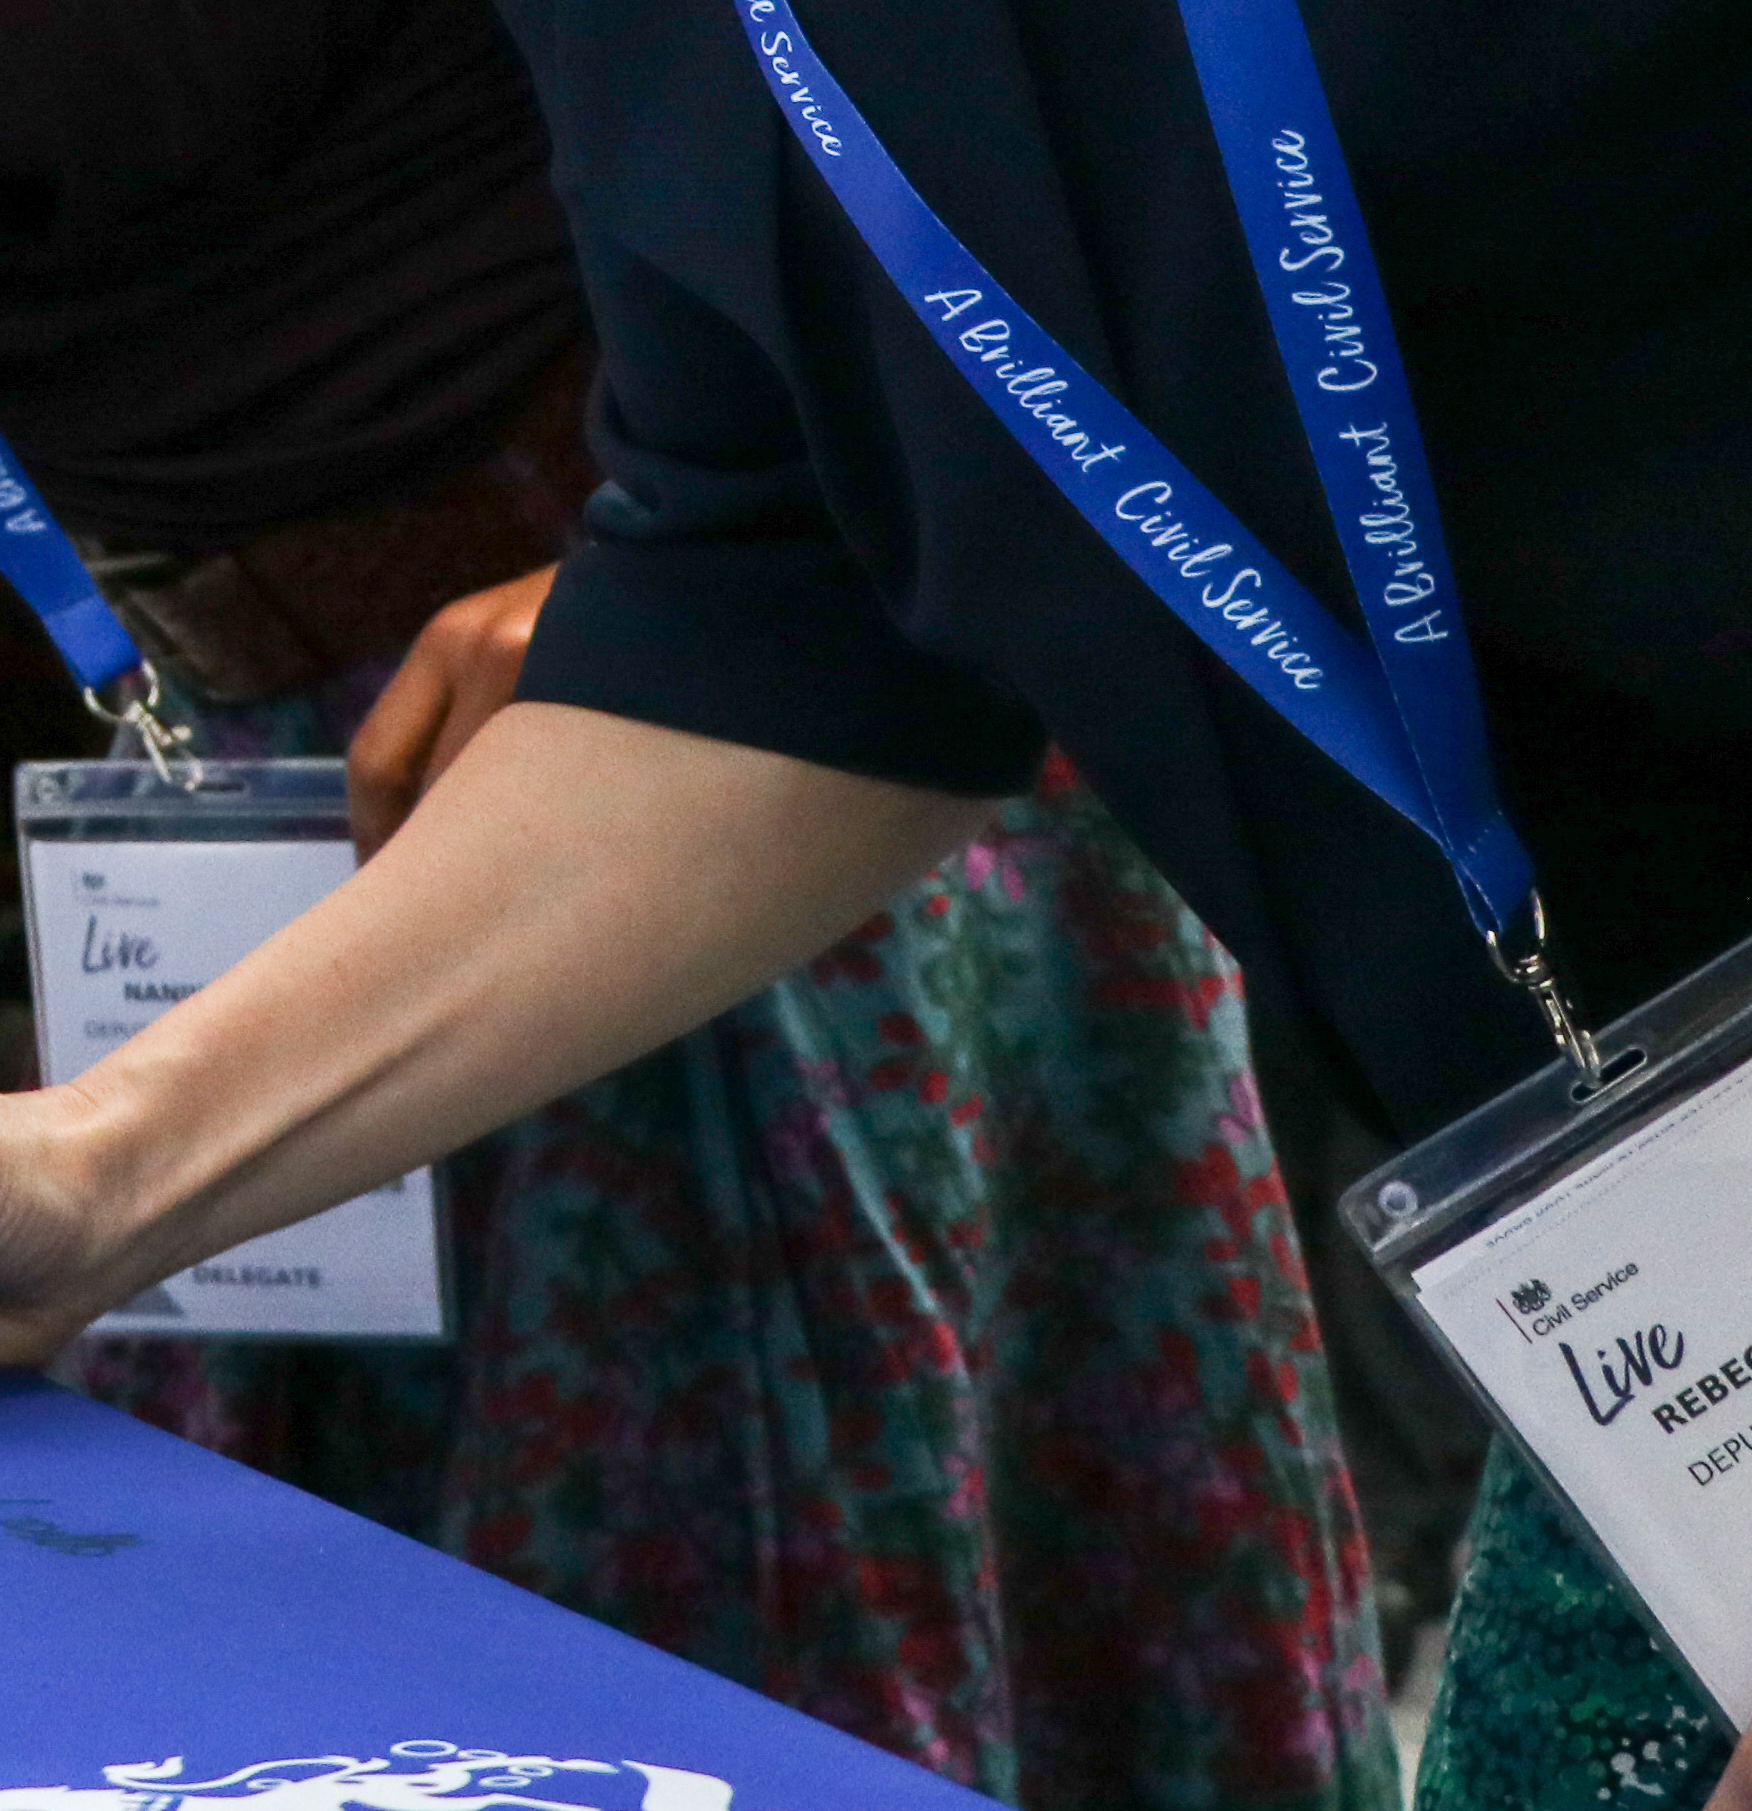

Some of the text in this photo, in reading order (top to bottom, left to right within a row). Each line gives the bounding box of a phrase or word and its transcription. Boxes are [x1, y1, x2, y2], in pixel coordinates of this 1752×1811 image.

[759, 27, 842, 157] Service
[1270, 128, 1348, 276] Service
[1290, 279, 1379, 392] Civil
[925, 285, 1324, 693] A Brilliant Civil Service
[1340, 421, 1448, 644] A Brilliant
[83, 915, 159, 972] Live
[193, 1265, 321, 1286] DELEGATE
[1532, 1262, 1639, 1336] Civil Service
[1558, 1322, 1685, 1426] Live
